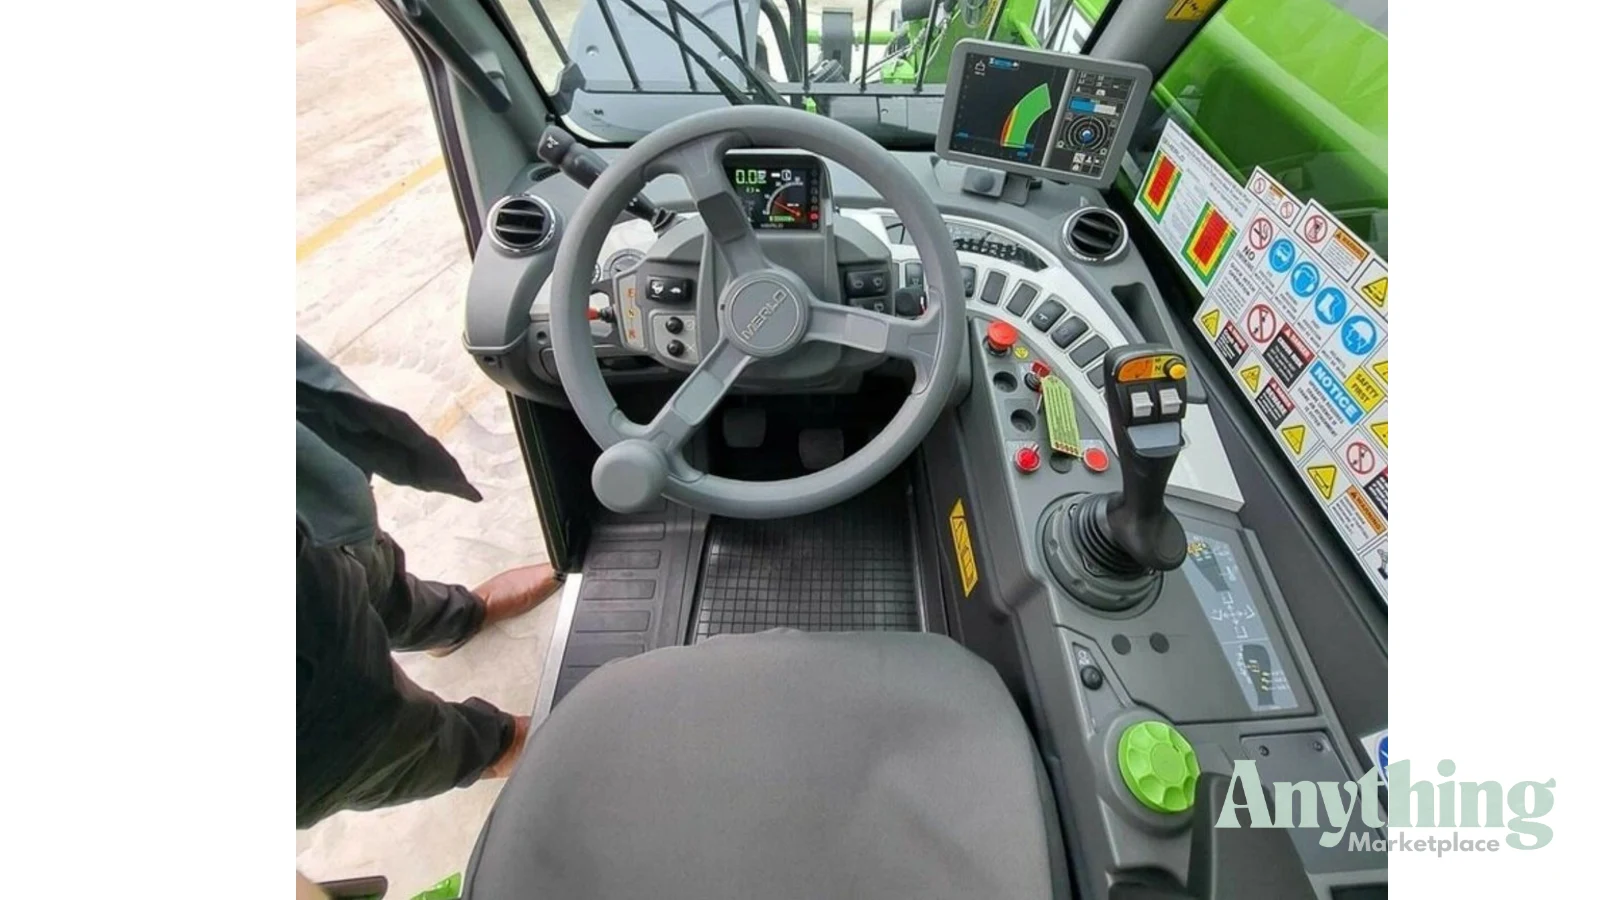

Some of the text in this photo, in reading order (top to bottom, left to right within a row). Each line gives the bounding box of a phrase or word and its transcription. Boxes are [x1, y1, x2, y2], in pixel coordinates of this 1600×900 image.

[1242, 245, 1256, 261] NO
[741, 289, 788, 340] MERLO
[1313, 366, 1358, 418] NOTICE
[1351, 382, 1369, 403] FIRST
[1355, 372, 1378, 398] SAFETY
[1355, 496, 1381, 530] WARNING
